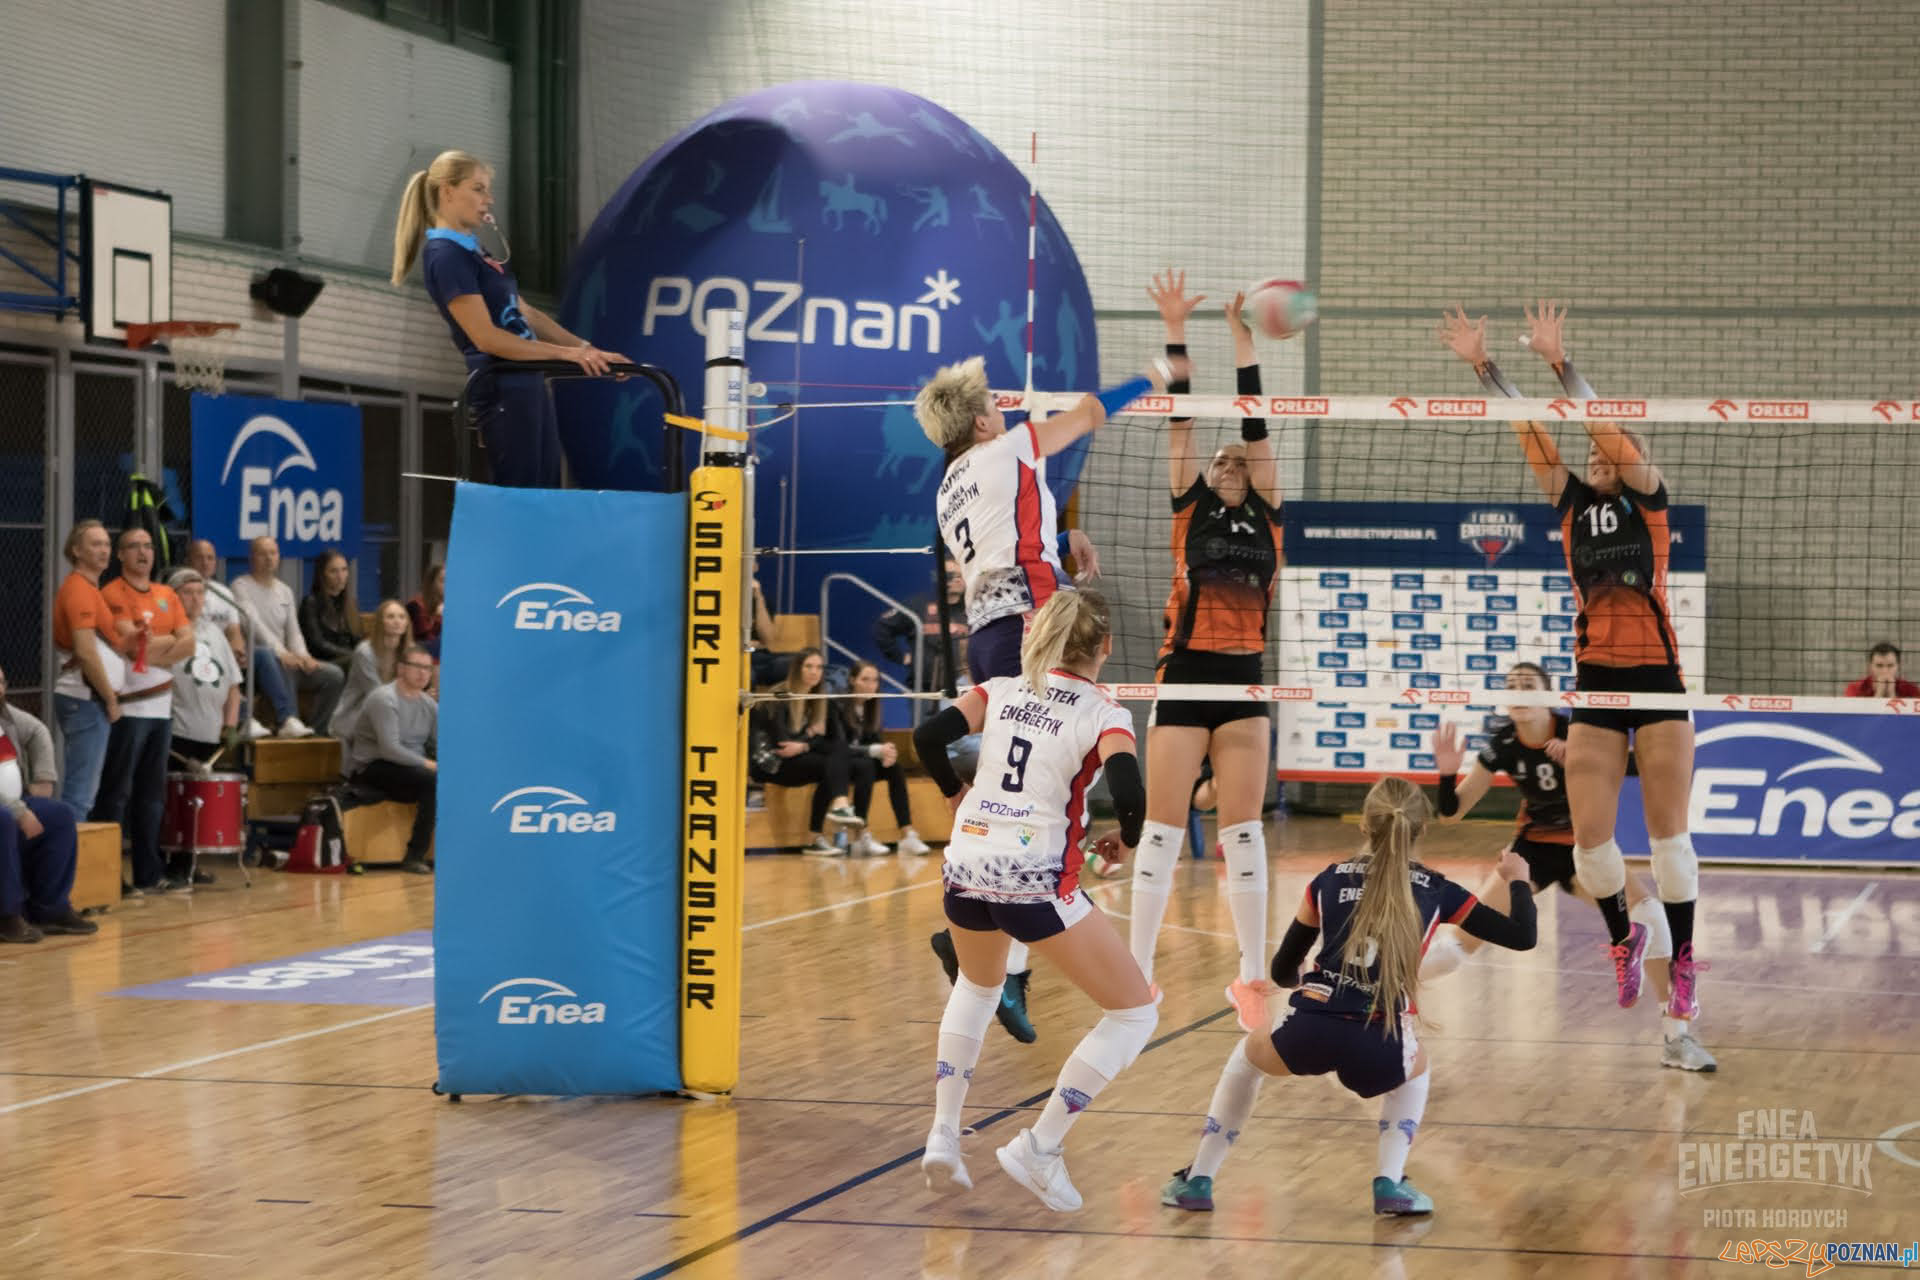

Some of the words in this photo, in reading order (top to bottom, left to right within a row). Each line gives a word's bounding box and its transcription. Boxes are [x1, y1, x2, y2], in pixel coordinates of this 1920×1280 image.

[1274, 399, 1327, 413] ORLEN
[1430, 401, 1484, 415] ORLEN
[1588, 403, 1644, 416] ORLEN
[1750, 404, 1807, 417] ORLEN
[239, 466, 343, 542] Enea
[1584, 503, 1618, 537] 16
[955, 517, 976, 564] 3
[515, 601, 622, 633] Enea
[693, 522, 723, 684] SPORT
[1118, 686, 1157, 698] ORLEN
[1273, 688, 1312, 700] ORLEN
[1430, 691, 1469, 703] ORLEN
[1588, 694, 1630, 706] ORLEN
[1750, 698, 1791, 710] ORLEN
[1000, 704, 1064, 736] ENERGETYK
[1001, 735, 1033, 793] 9
[1536, 763, 1558, 791] 8
[510, 805, 617, 833] Enea
[687, 746, 718, 1010] TRANSFER
[497, 996, 607, 1025] Enea
